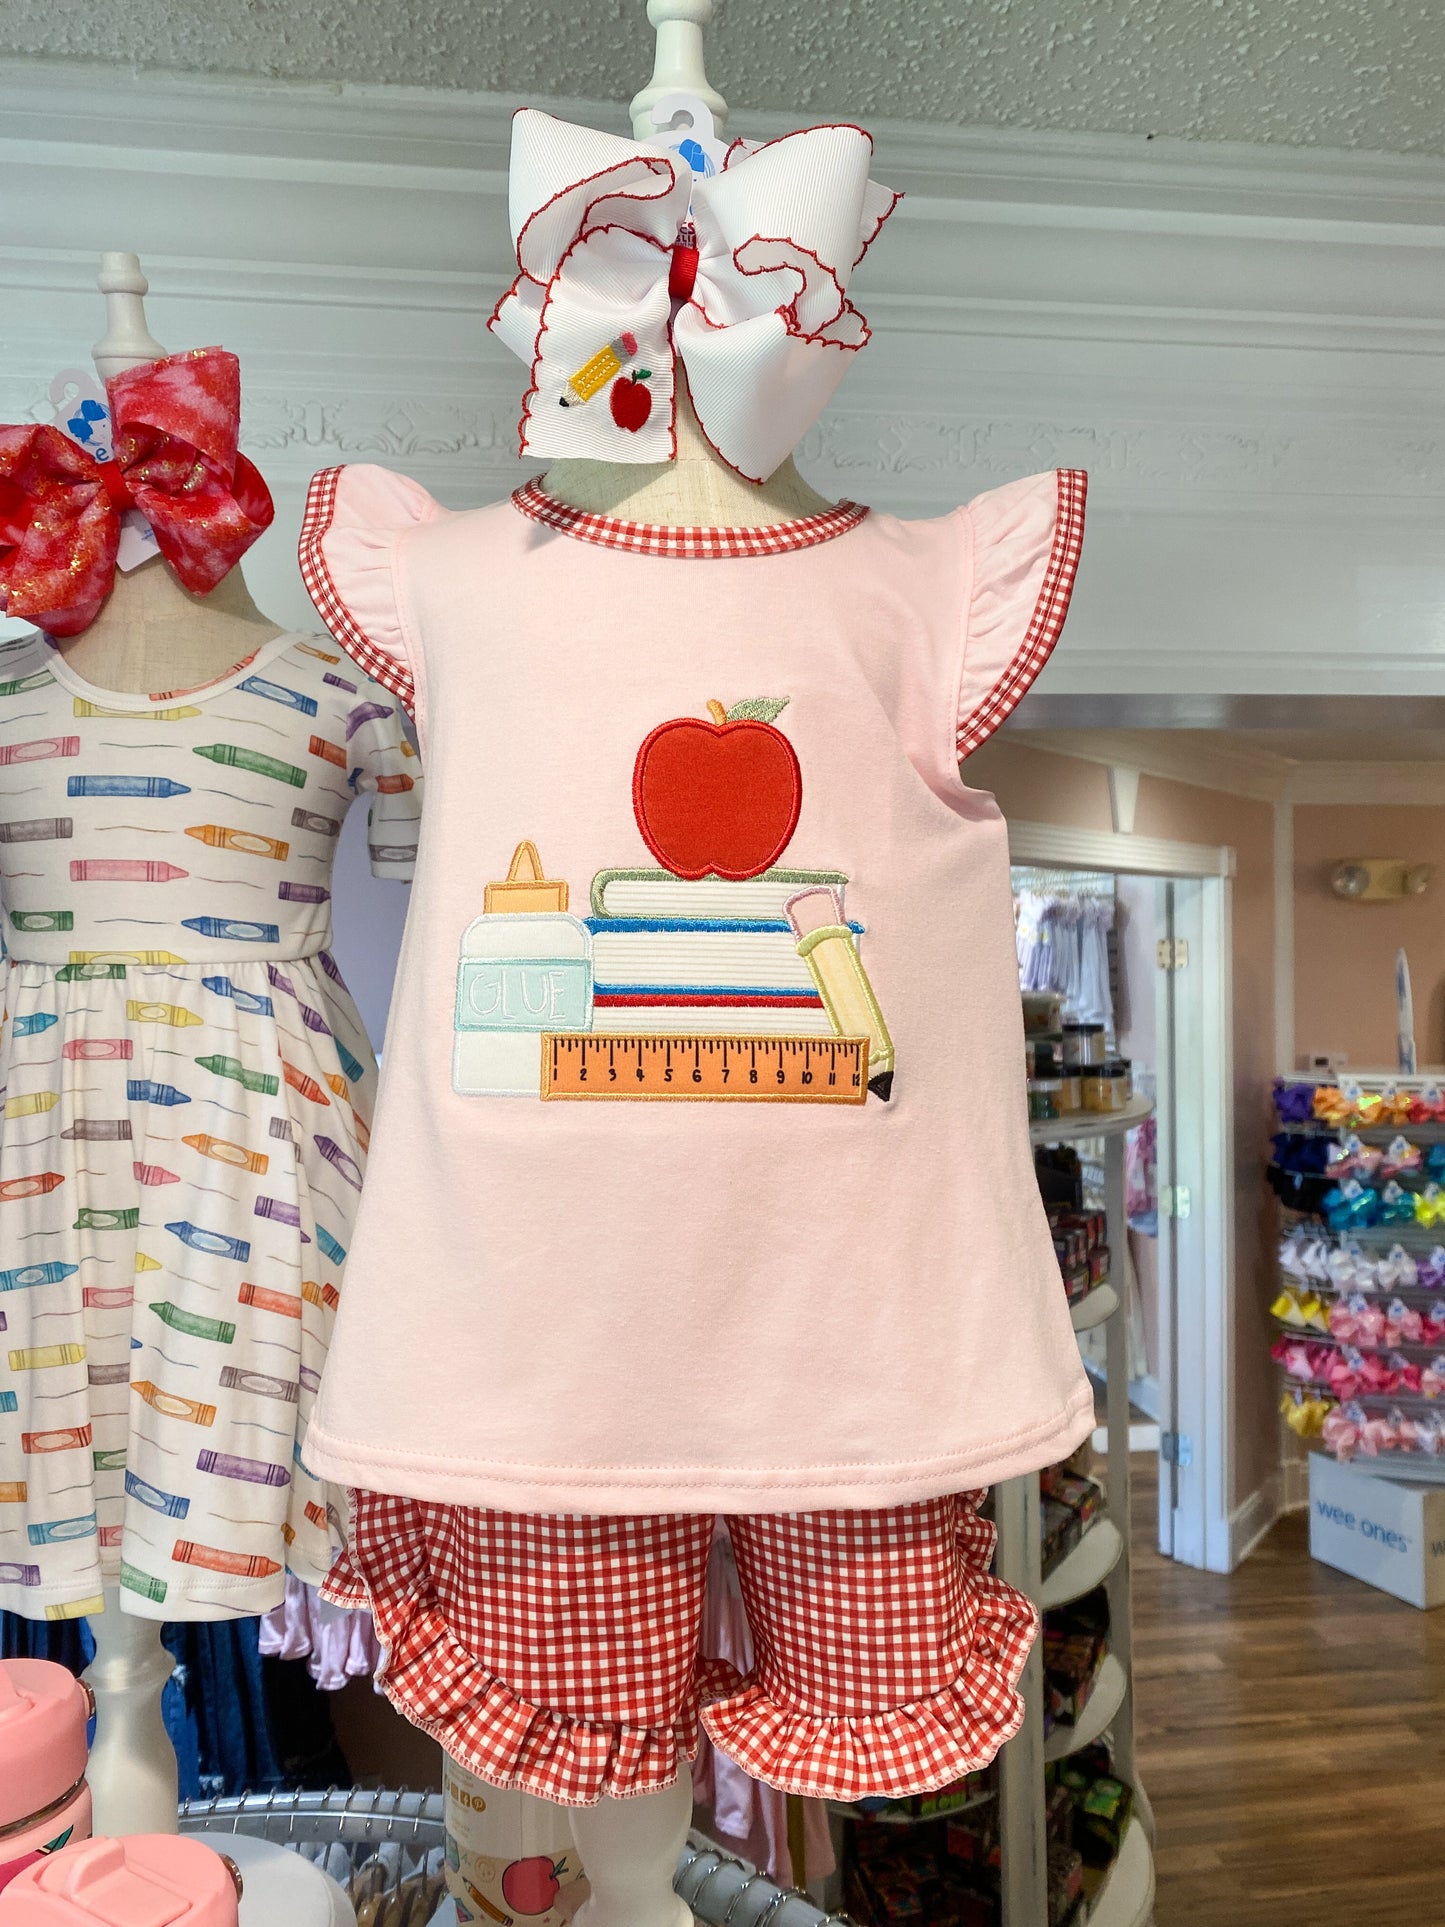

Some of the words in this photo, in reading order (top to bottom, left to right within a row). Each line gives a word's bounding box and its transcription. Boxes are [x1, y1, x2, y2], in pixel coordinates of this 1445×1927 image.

[469, 970, 567, 1022] GLUE
[579, 1068, 587, 1081] 2
[608, 1068, 617, 1082] 3
[636, 1068, 645, 1082] 4
[664, 1068, 673, 1082] 5
[692, 1069, 702, 1082] 6
[721, 1069, 730, 1083] 7
[749, 1070, 758, 1084] 8
[776, 1070, 786, 1084] 9
[801, 1071, 813, 1085] 10
[828, 1072, 836, 1086] 11
[1317, 1500, 1356, 1531] wee
[1360, 1518, 1408, 1553] ones
